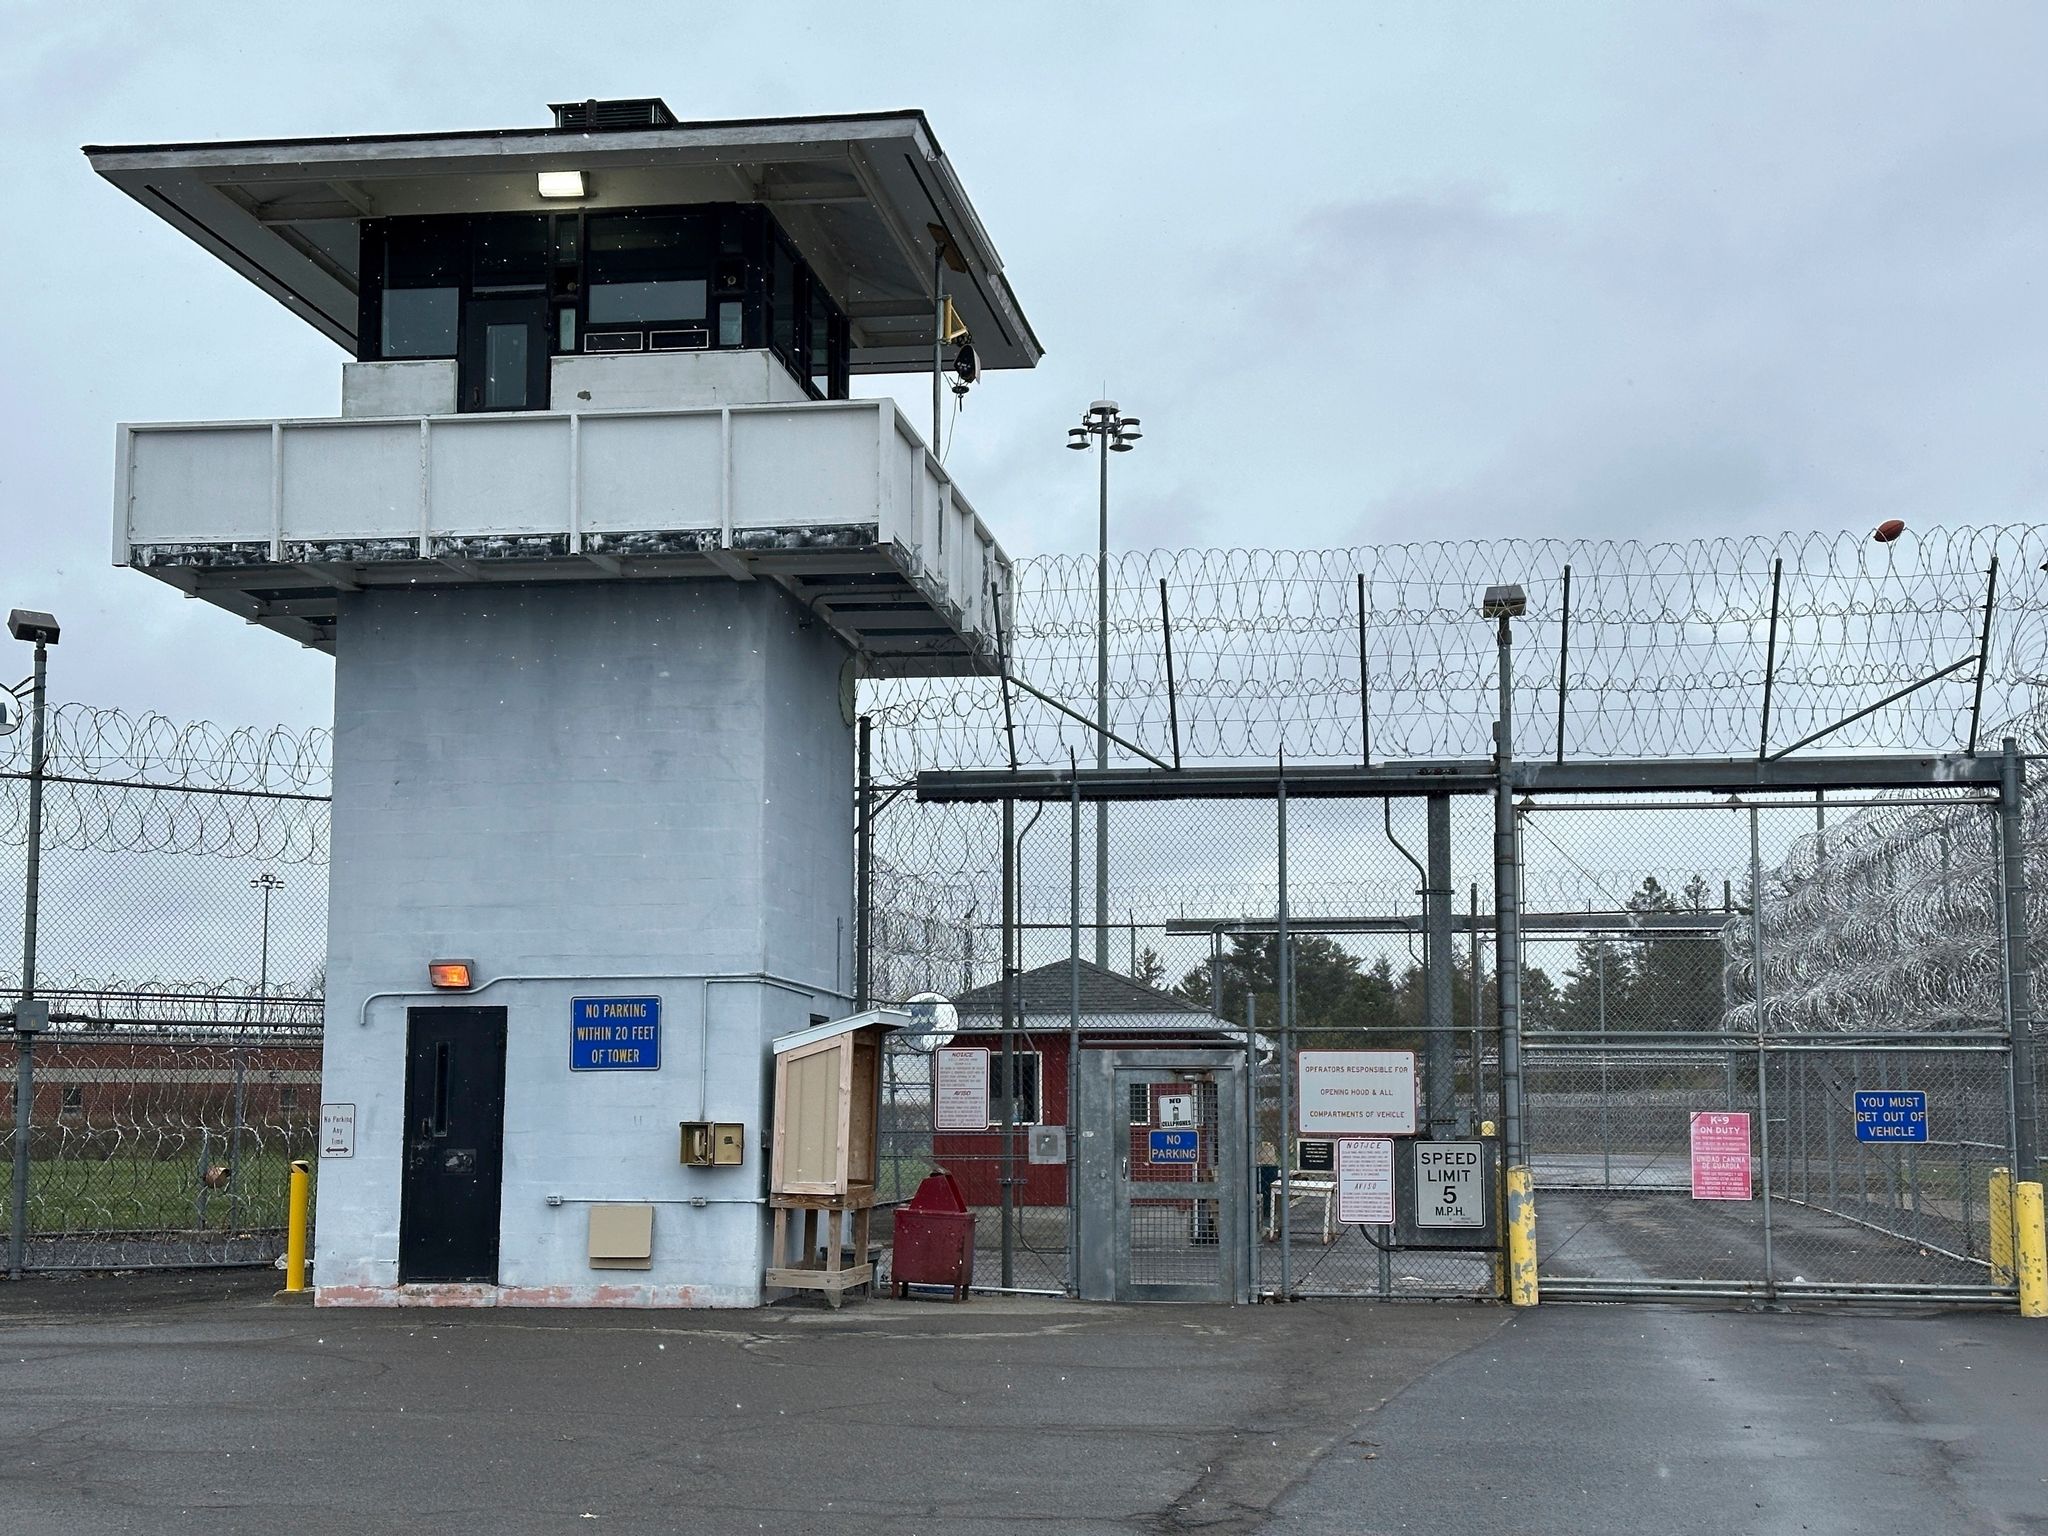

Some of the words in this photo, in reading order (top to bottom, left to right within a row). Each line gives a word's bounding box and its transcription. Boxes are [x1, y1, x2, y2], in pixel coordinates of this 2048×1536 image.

[586, 1004, 599, 1018] NO
[604, 1004, 647, 1018] PARKING
[577, 1027, 611, 1041] WITHIN
[616, 1026, 628, 1040] 20
[632, 1026, 655, 1040] FEET
[592, 1050, 606, 1064] OF
[608, 1049, 640, 1063] TOWER
[1861, 1097, 1885, 1108] YOU
[1890, 1097, 1920, 1108] MUST
[1710, 1116, 1730, 1125] K-9
[1857, 1112, 1878, 1122] GET
[1883, 1112, 1905, 1122] OUT
[1910, 1112, 1925, 1122] OF
[1868, 1127, 1916, 1137] VEHICLE
[1166, 1135, 1181, 1145] NO
[1152, 1149, 1196, 1159] PARKING
[1421, 1152, 1477, 1165] SPEED
[1428, 1170, 1471, 1182] LIMIT
[1443, 1186, 1457, 1204] 5
[1435, 1206, 1466, 1217] M.P.H.
